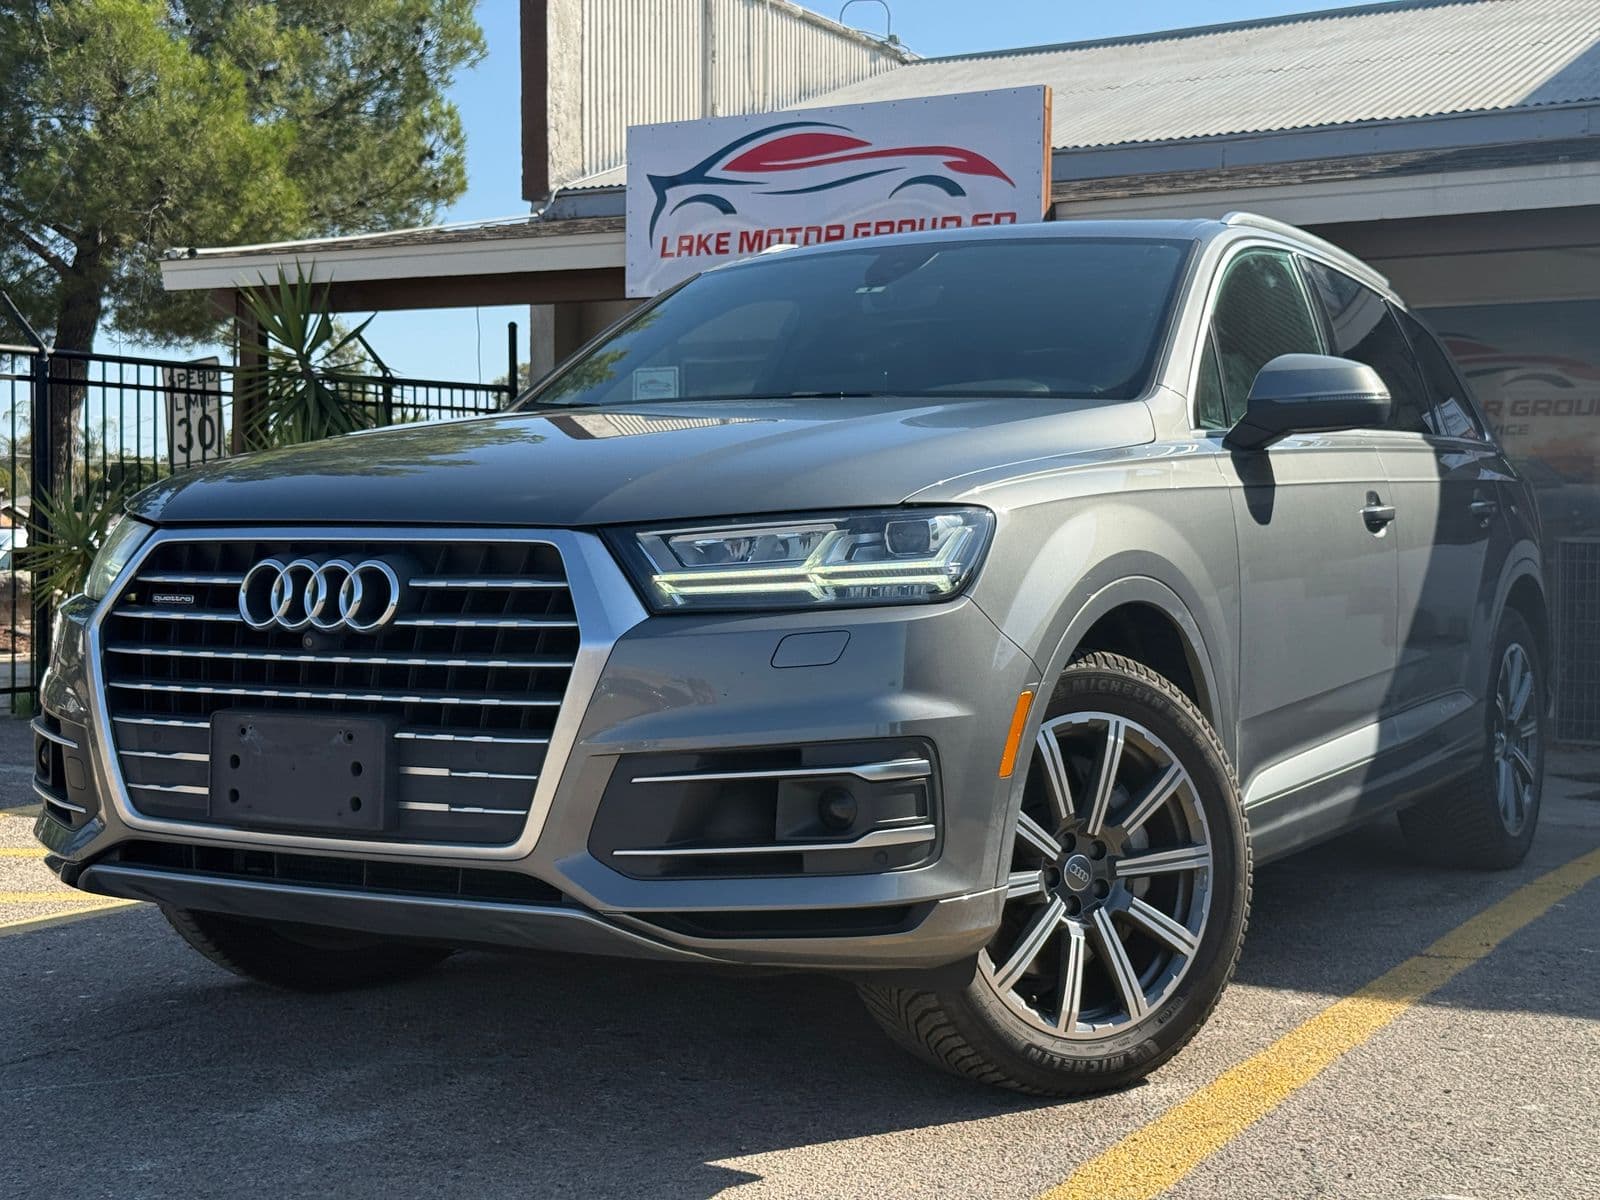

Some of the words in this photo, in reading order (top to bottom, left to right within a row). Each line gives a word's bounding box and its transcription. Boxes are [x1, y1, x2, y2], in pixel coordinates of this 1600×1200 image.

[660, 232, 732, 259] LAKE
[738, 224, 845, 255] MOTOR
[1510, 400, 1600, 416] GROU
[177, 414, 215, 453] 30
[153, 595, 192, 603] quattro
[1071, 678, 1166, 709] MICHELIN
[1026, 1047, 1126, 1074] MICHELIN
